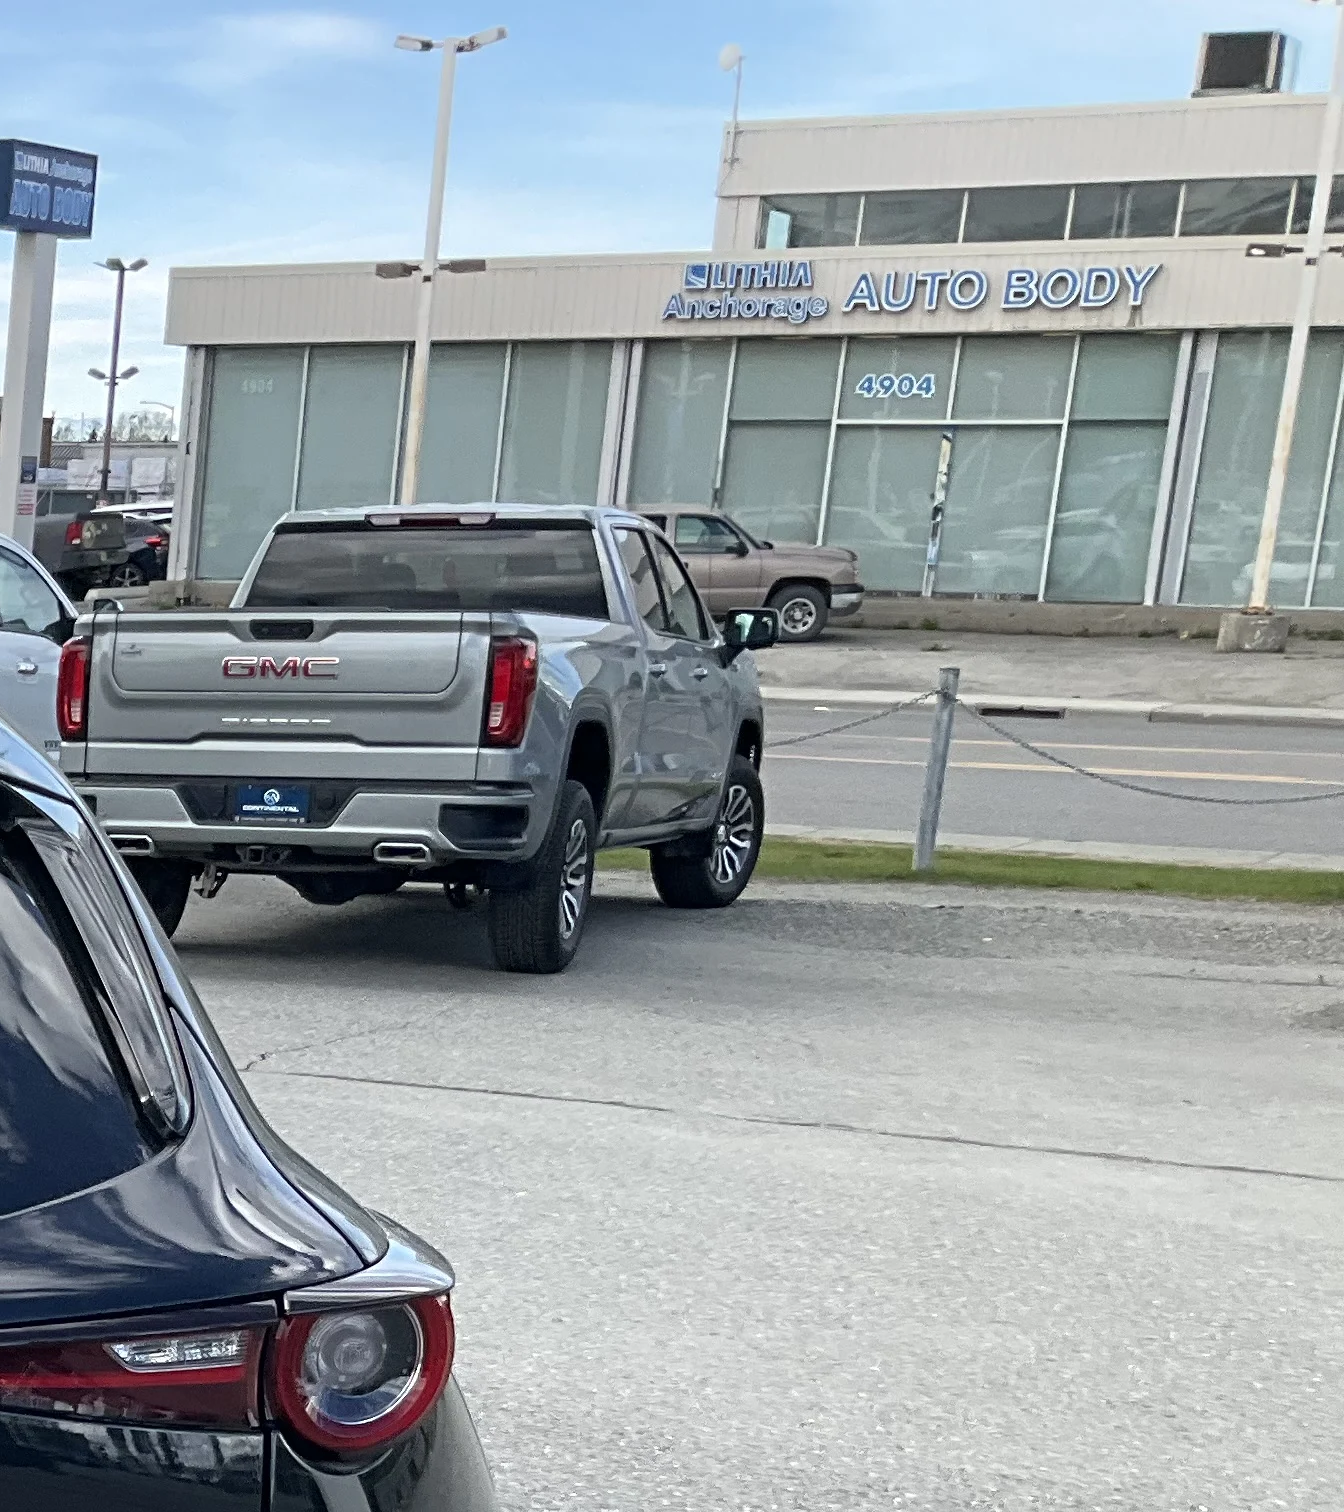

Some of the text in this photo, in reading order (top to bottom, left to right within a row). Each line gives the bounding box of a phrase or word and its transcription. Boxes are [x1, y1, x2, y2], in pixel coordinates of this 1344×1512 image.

[711, 260, 813, 290] LITHIA
[842, 263, 1163, 313] AUTO BODY
[662, 290, 829, 325] Anchorage
[854, 373, 936, 399] 4904
[222, 656, 340, 680] GMC
